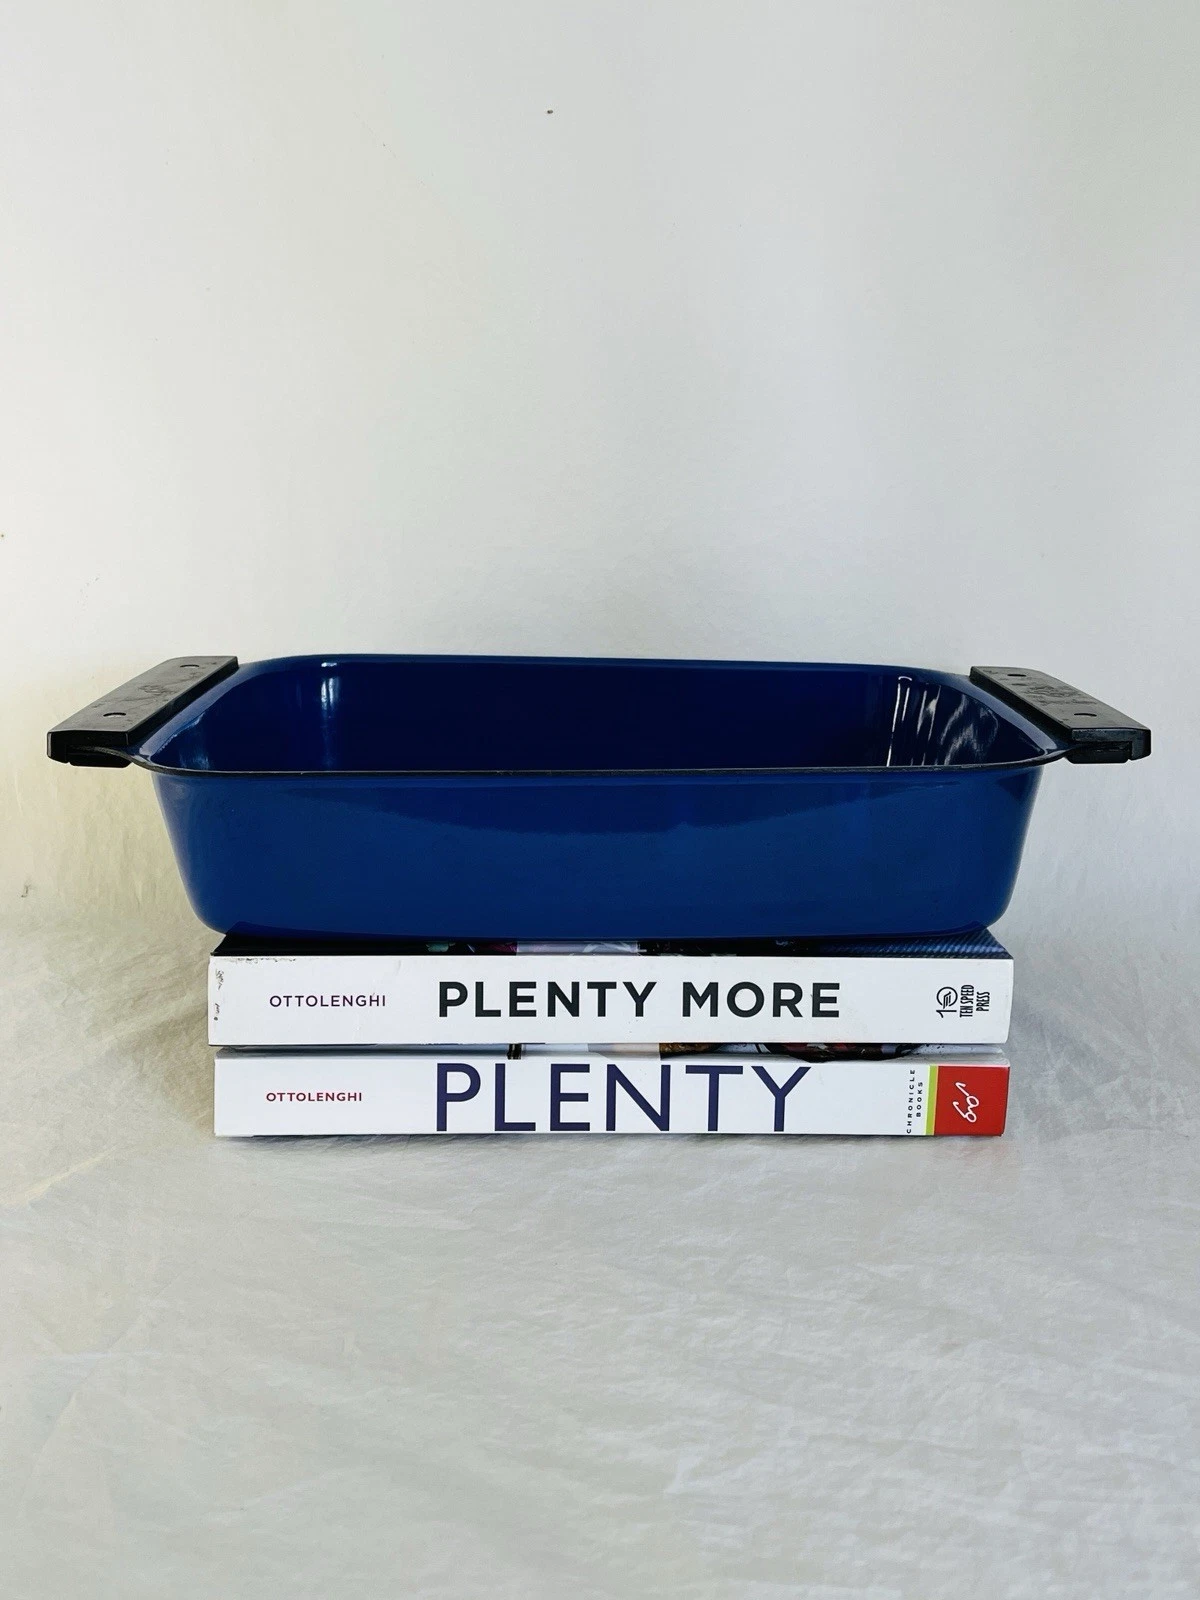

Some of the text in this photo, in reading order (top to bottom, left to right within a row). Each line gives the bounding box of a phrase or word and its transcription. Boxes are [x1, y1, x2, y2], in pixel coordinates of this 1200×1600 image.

[269, 994, 386, 1008] OTTOLENGHI
[438, 981, 840, 1018] PLENTY MORE
[960, 984, 975, 1018] TEN SPEED
[976, 991, 990, 1011] PRESS
[266, 1092, 363, 1102] OTTOLENGHI
[436, 1062, 811, 1132] PLENTY
[906, 1069, 916, 1134] CHRONICLE
[916, 1081, 924, 1117] BOOKS
